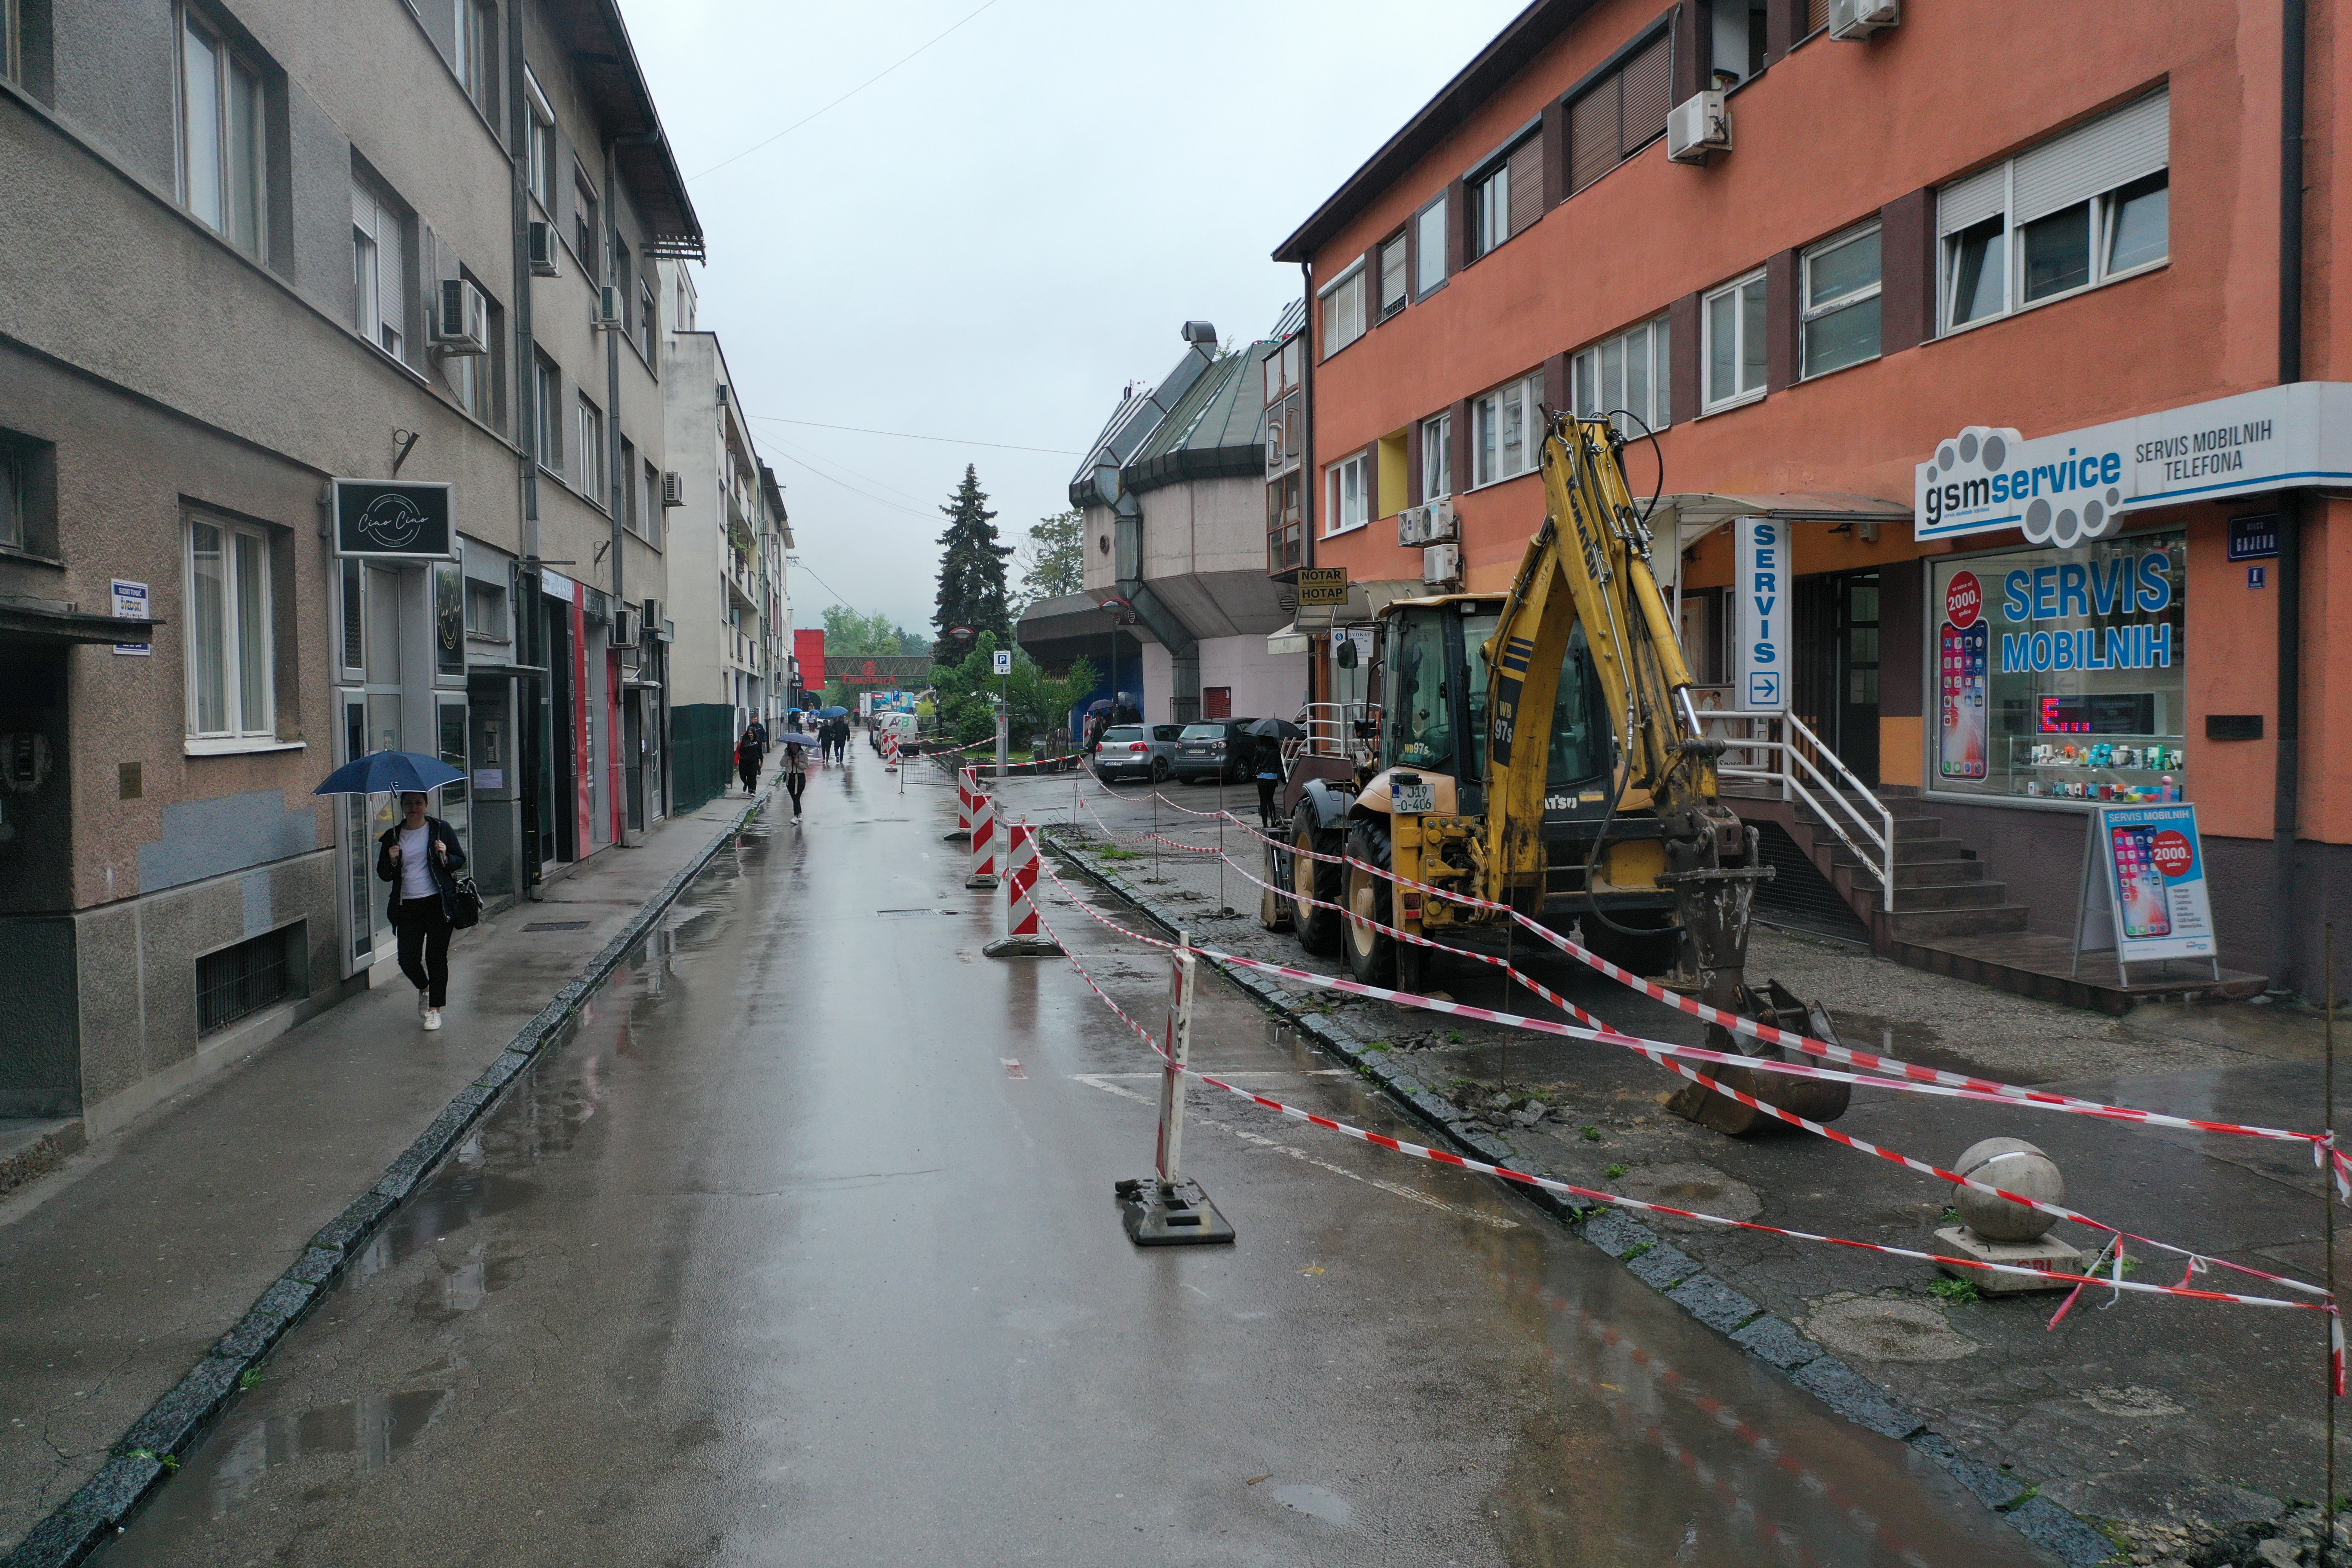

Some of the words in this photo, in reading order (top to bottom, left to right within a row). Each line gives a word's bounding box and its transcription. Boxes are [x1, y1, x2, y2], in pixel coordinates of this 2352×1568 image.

[2136, 435, 2188, 463] SERVIS
[2193, 419, 2272, 453] MOBILNIH
[2164, 450, 2242, 481] TELEFONA
[1926, 447, 2121, 525] gsmservice
[358, 514, 392, 532] Ciao
[395, 511, 429, 530] Ciao
[1301, 570, 1342, 580] NOTAR
[2252, 569, 2258, 582] 1
[1302, 588, 1343, 598] НОТАР
[1753, 524, 1776, 663] SERVIS
[2003, 553, 2171, 623] SERVIS
[120, 597, 141, 612] ŠVEDSKI
[1948, 589, 1979, 611] 2000.
[2002, 623, 2171, 673] MOBILNIH
[1499, 700, 1512, 719] WB
[1494, 719, 1512, 743] 97s
[2109, 812, 2142, 822] SERVIS
[2143, 810, 2190, 820] MOBILNIH
[2153, 847, 2190, 861] 2000.
